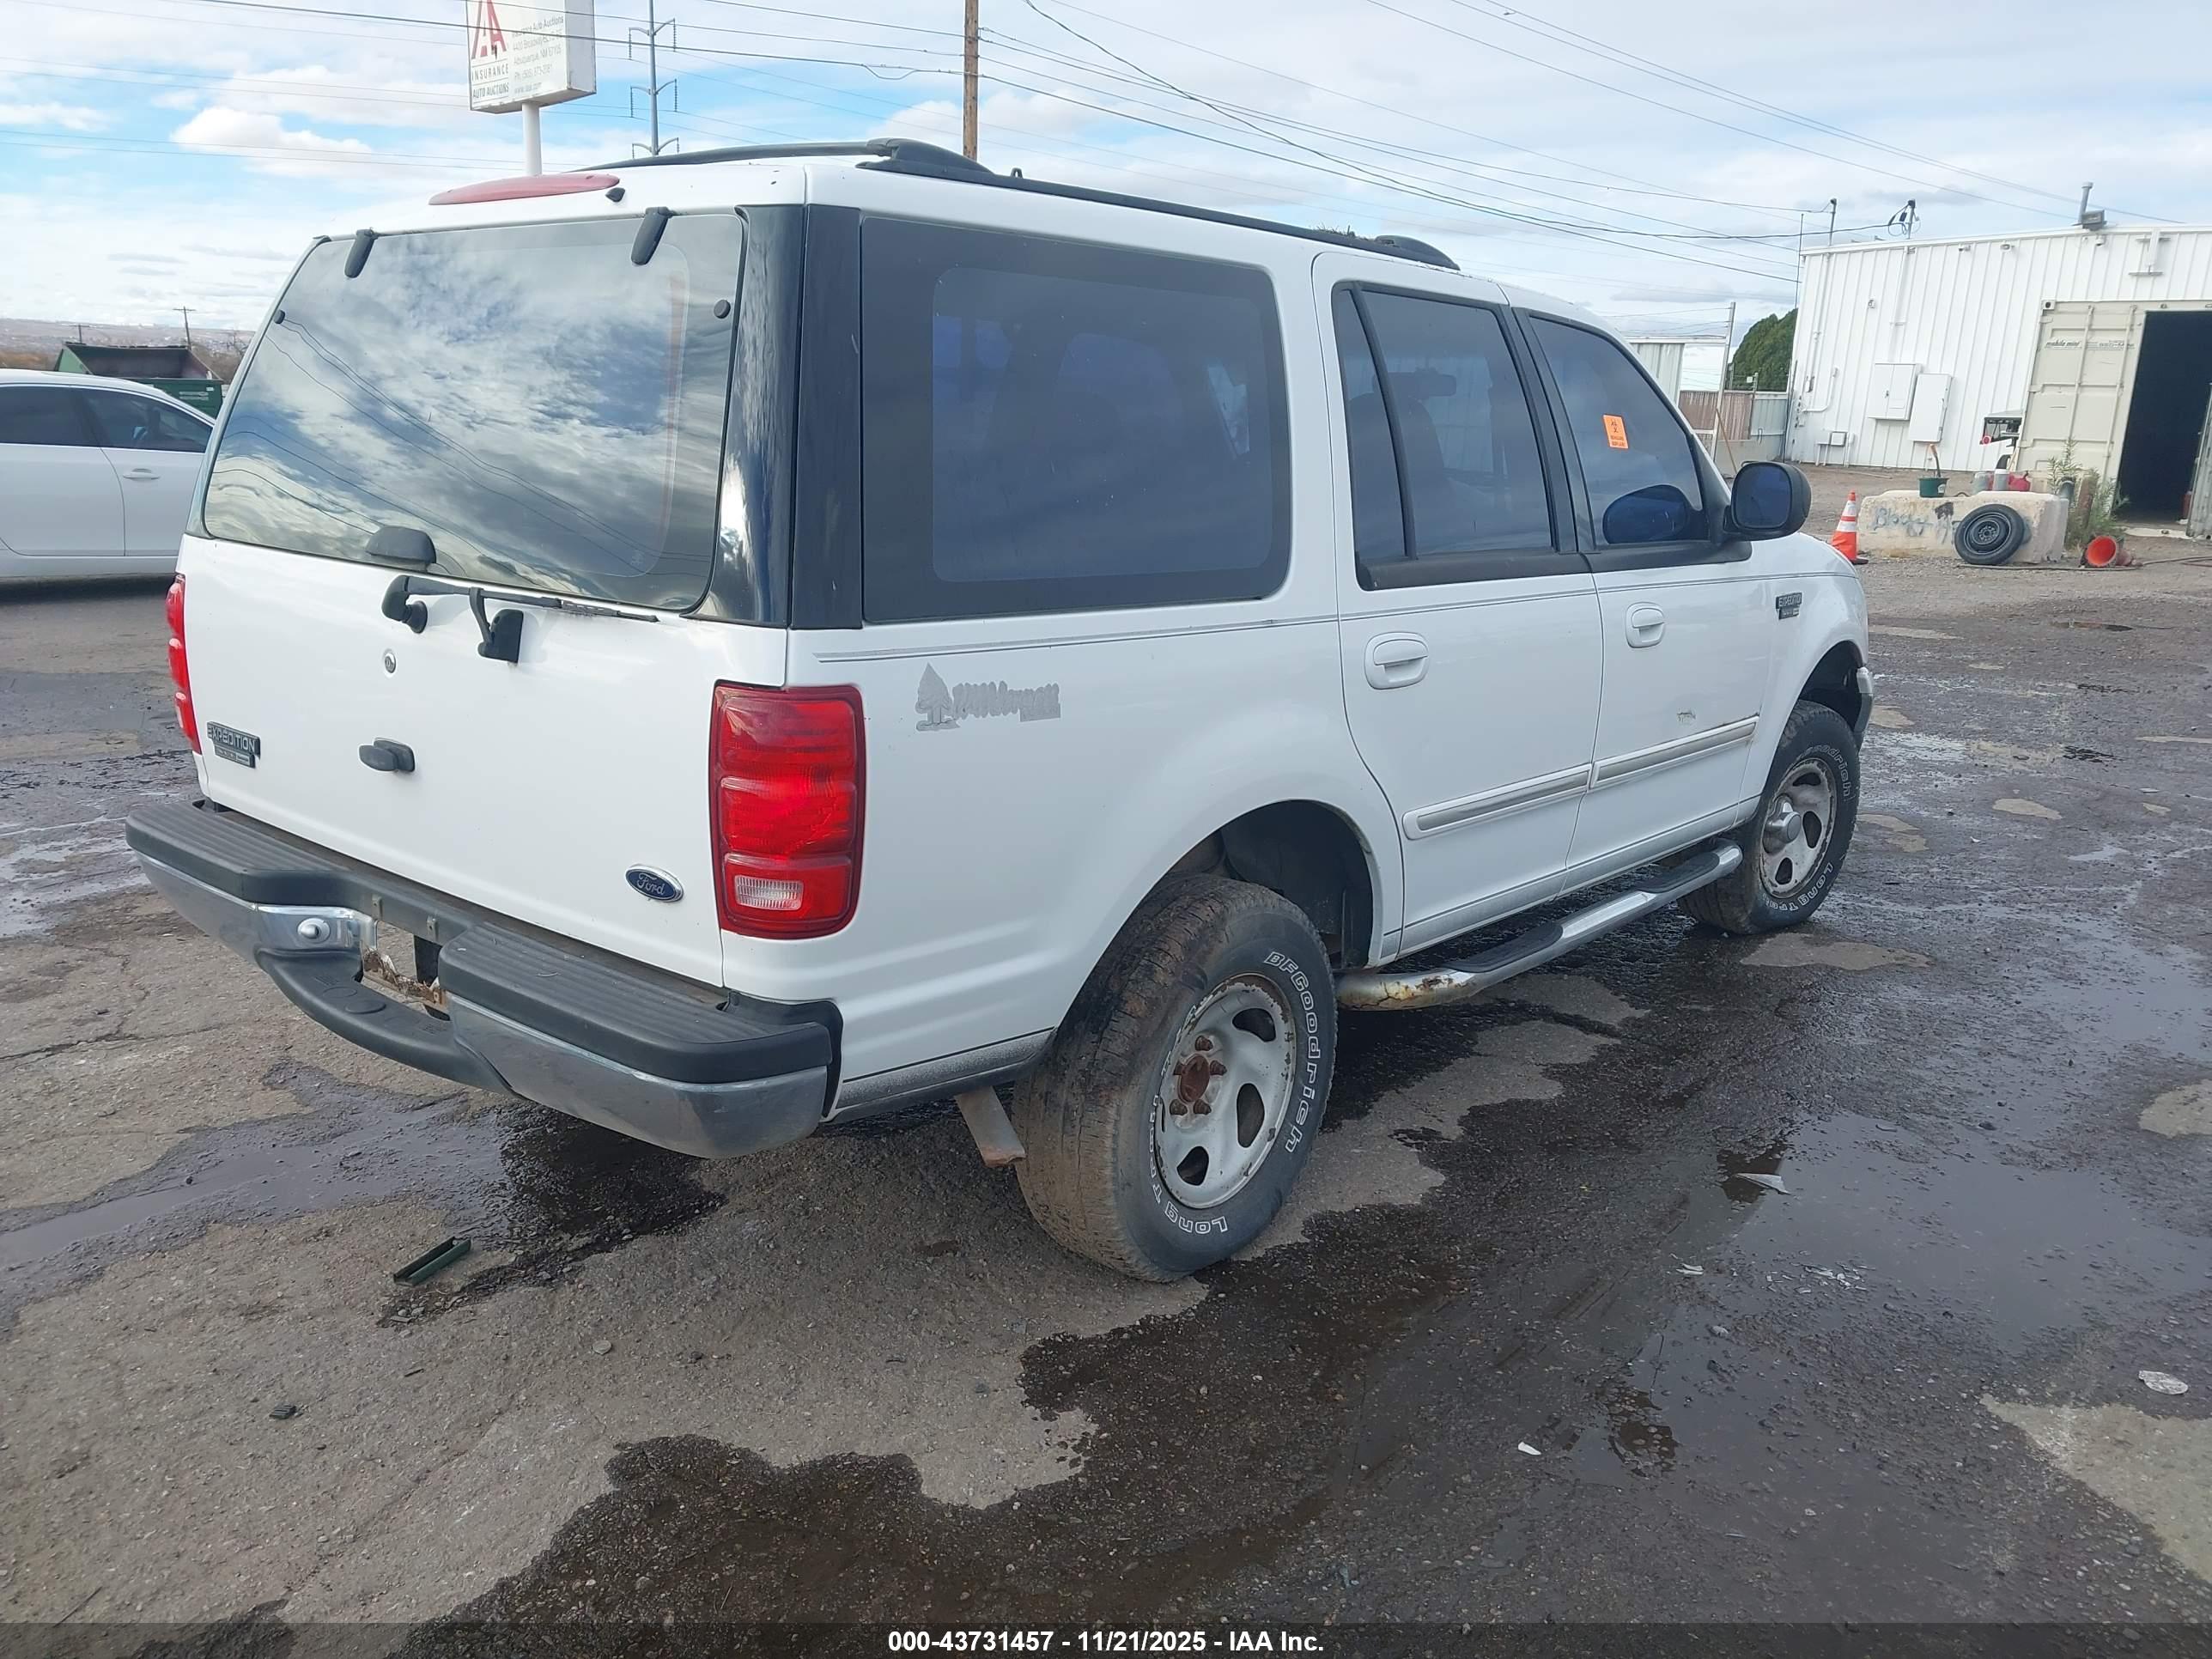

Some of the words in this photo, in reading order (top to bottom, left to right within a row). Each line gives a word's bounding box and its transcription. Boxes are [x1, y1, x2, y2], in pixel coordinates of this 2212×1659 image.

[544, 16, 563, 27] Auctions
[471, 64, 508, 82] INSURANCE
[473, 87, 486, 99] AUTO
[486, 82, 508, 96] AUCTIONS
[208, 725, 255, 752] EXPEDITION
[636, 872, 665, 896] Ford
[1264, 951, 1322, 1154] BFGoodrich
